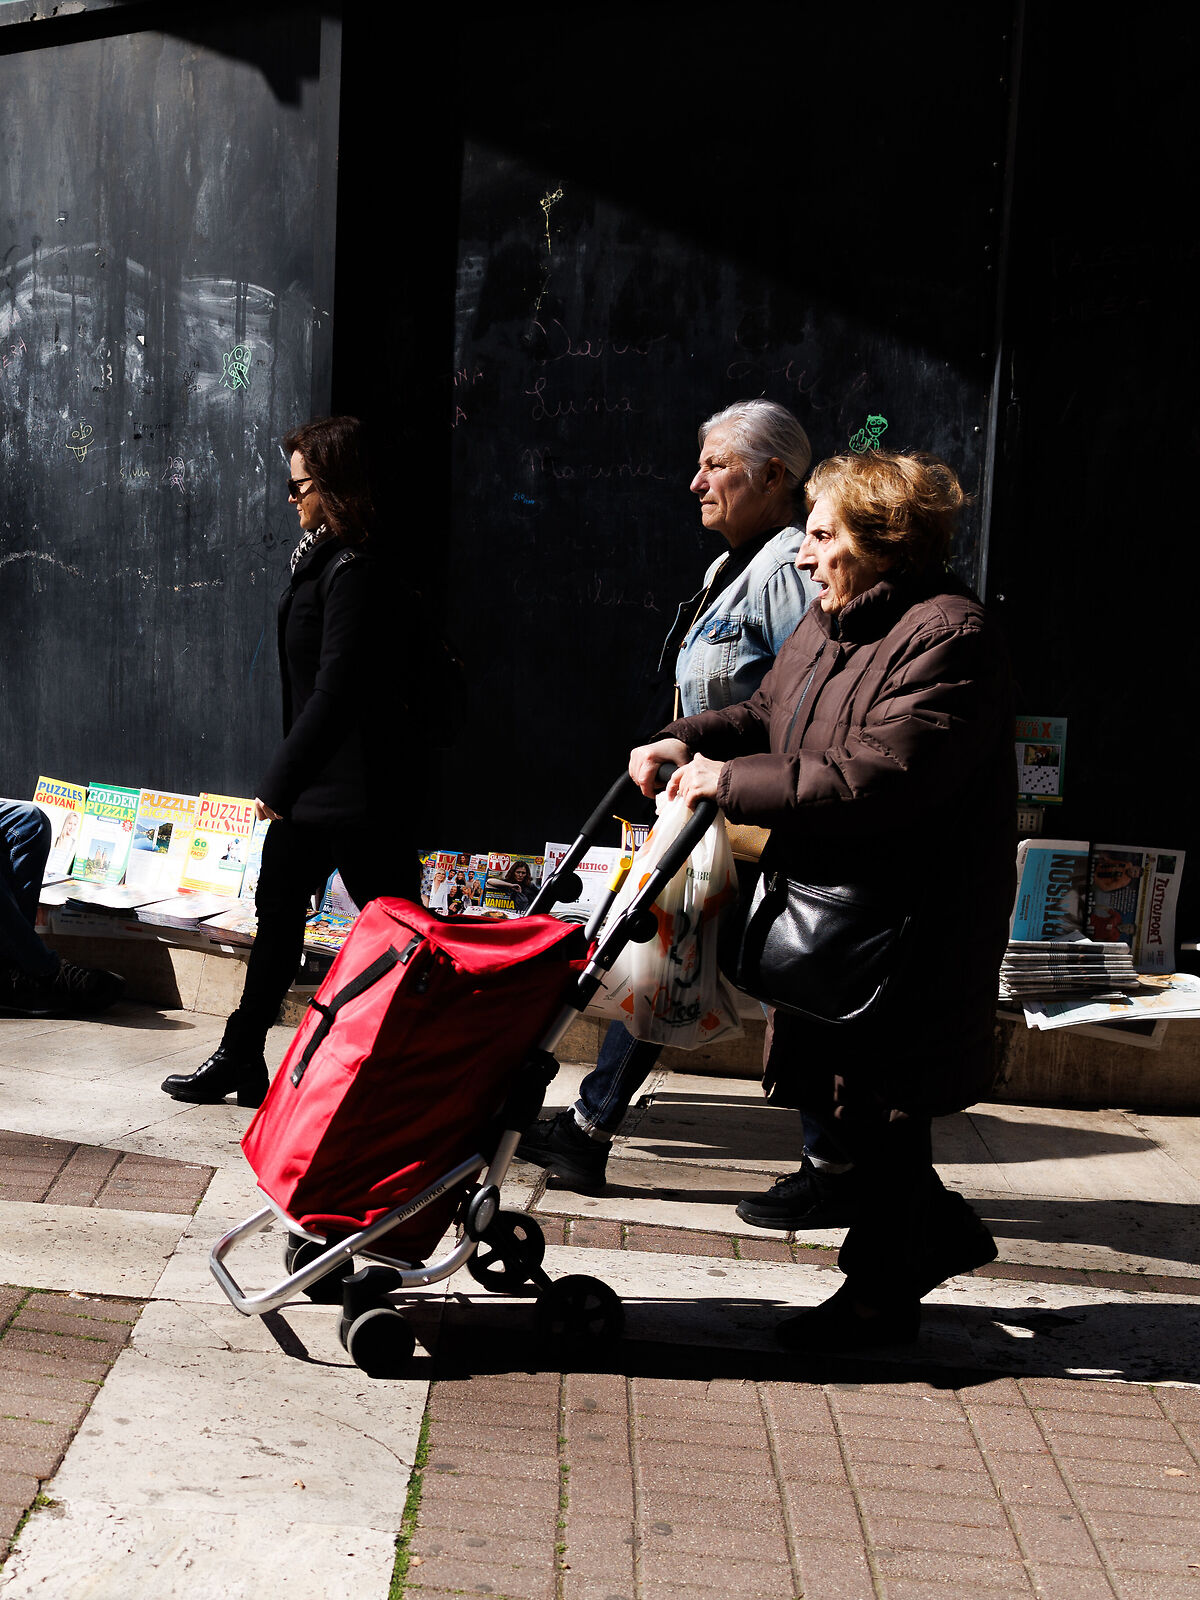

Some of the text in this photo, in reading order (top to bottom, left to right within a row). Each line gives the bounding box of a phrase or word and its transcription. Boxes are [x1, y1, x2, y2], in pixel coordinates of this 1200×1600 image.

[1015, 722, 1052, 738] ELAX
[38, 781, 83, 802] PUZZLES
[88, 789, 137, 808] GOLDEN
[85, 801, 136, 822] PUZZLE
[141, 792, 196, 813] PUZZLE
[200, 800, 252, 823] PUZZLE
[438, 854, 456, 863] TV
[490, 859, 509, 870] TV
[485, 898, 515, 909] VANINA
[397, 1183, 447, 1221] playmarket
